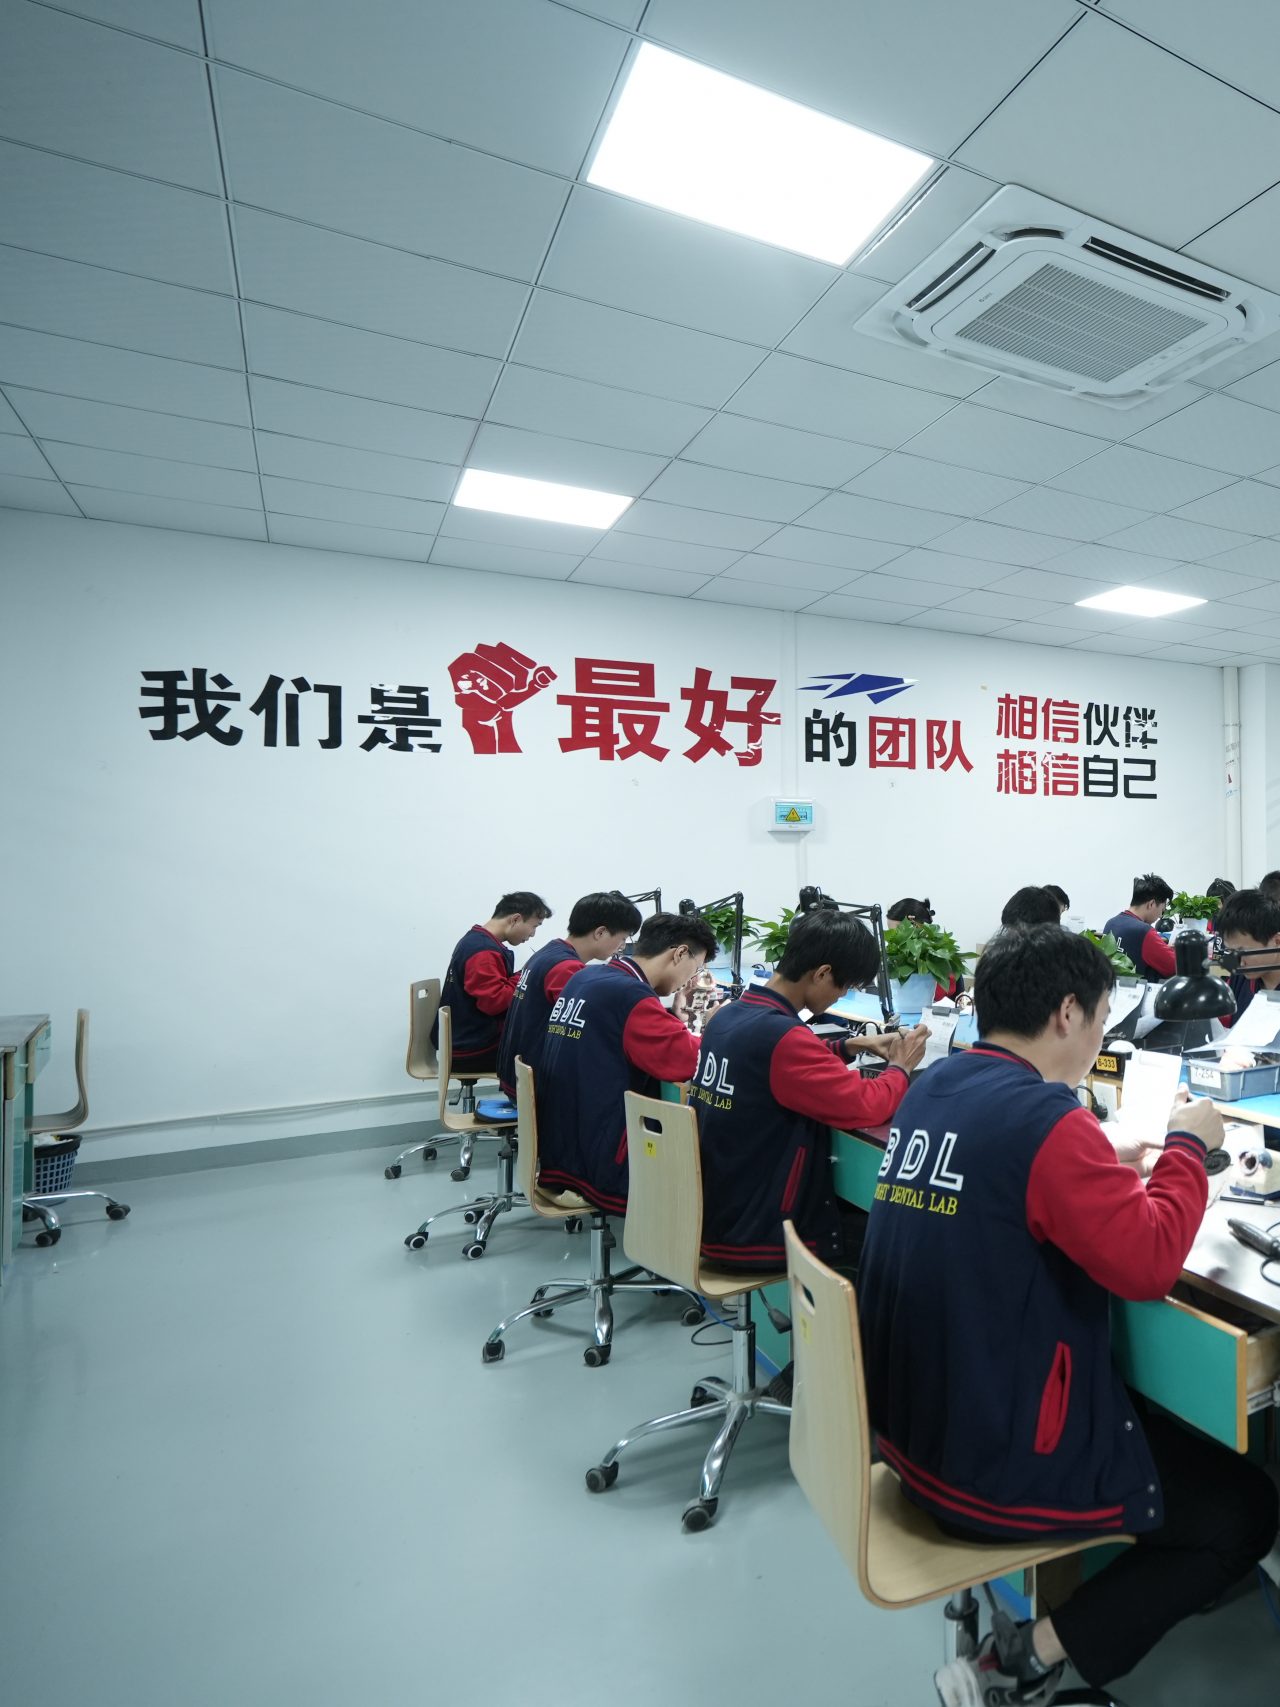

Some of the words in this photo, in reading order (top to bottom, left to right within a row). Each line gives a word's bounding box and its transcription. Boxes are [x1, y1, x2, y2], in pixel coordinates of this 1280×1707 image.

[138, 667, 443, 752] 我们是
[996, 692, 1158, 750] 相信伙伴
[996, 748, 1158, 800] 相信自己
[693, 1049, 735, 1096] DL
[714, 1095, 732, 1110] LAB
[878, 1127, 964, 1192] BDL
[889, 1184, 924, 1210] DENTAL
[930, 1191, 958, 1216] LAB
